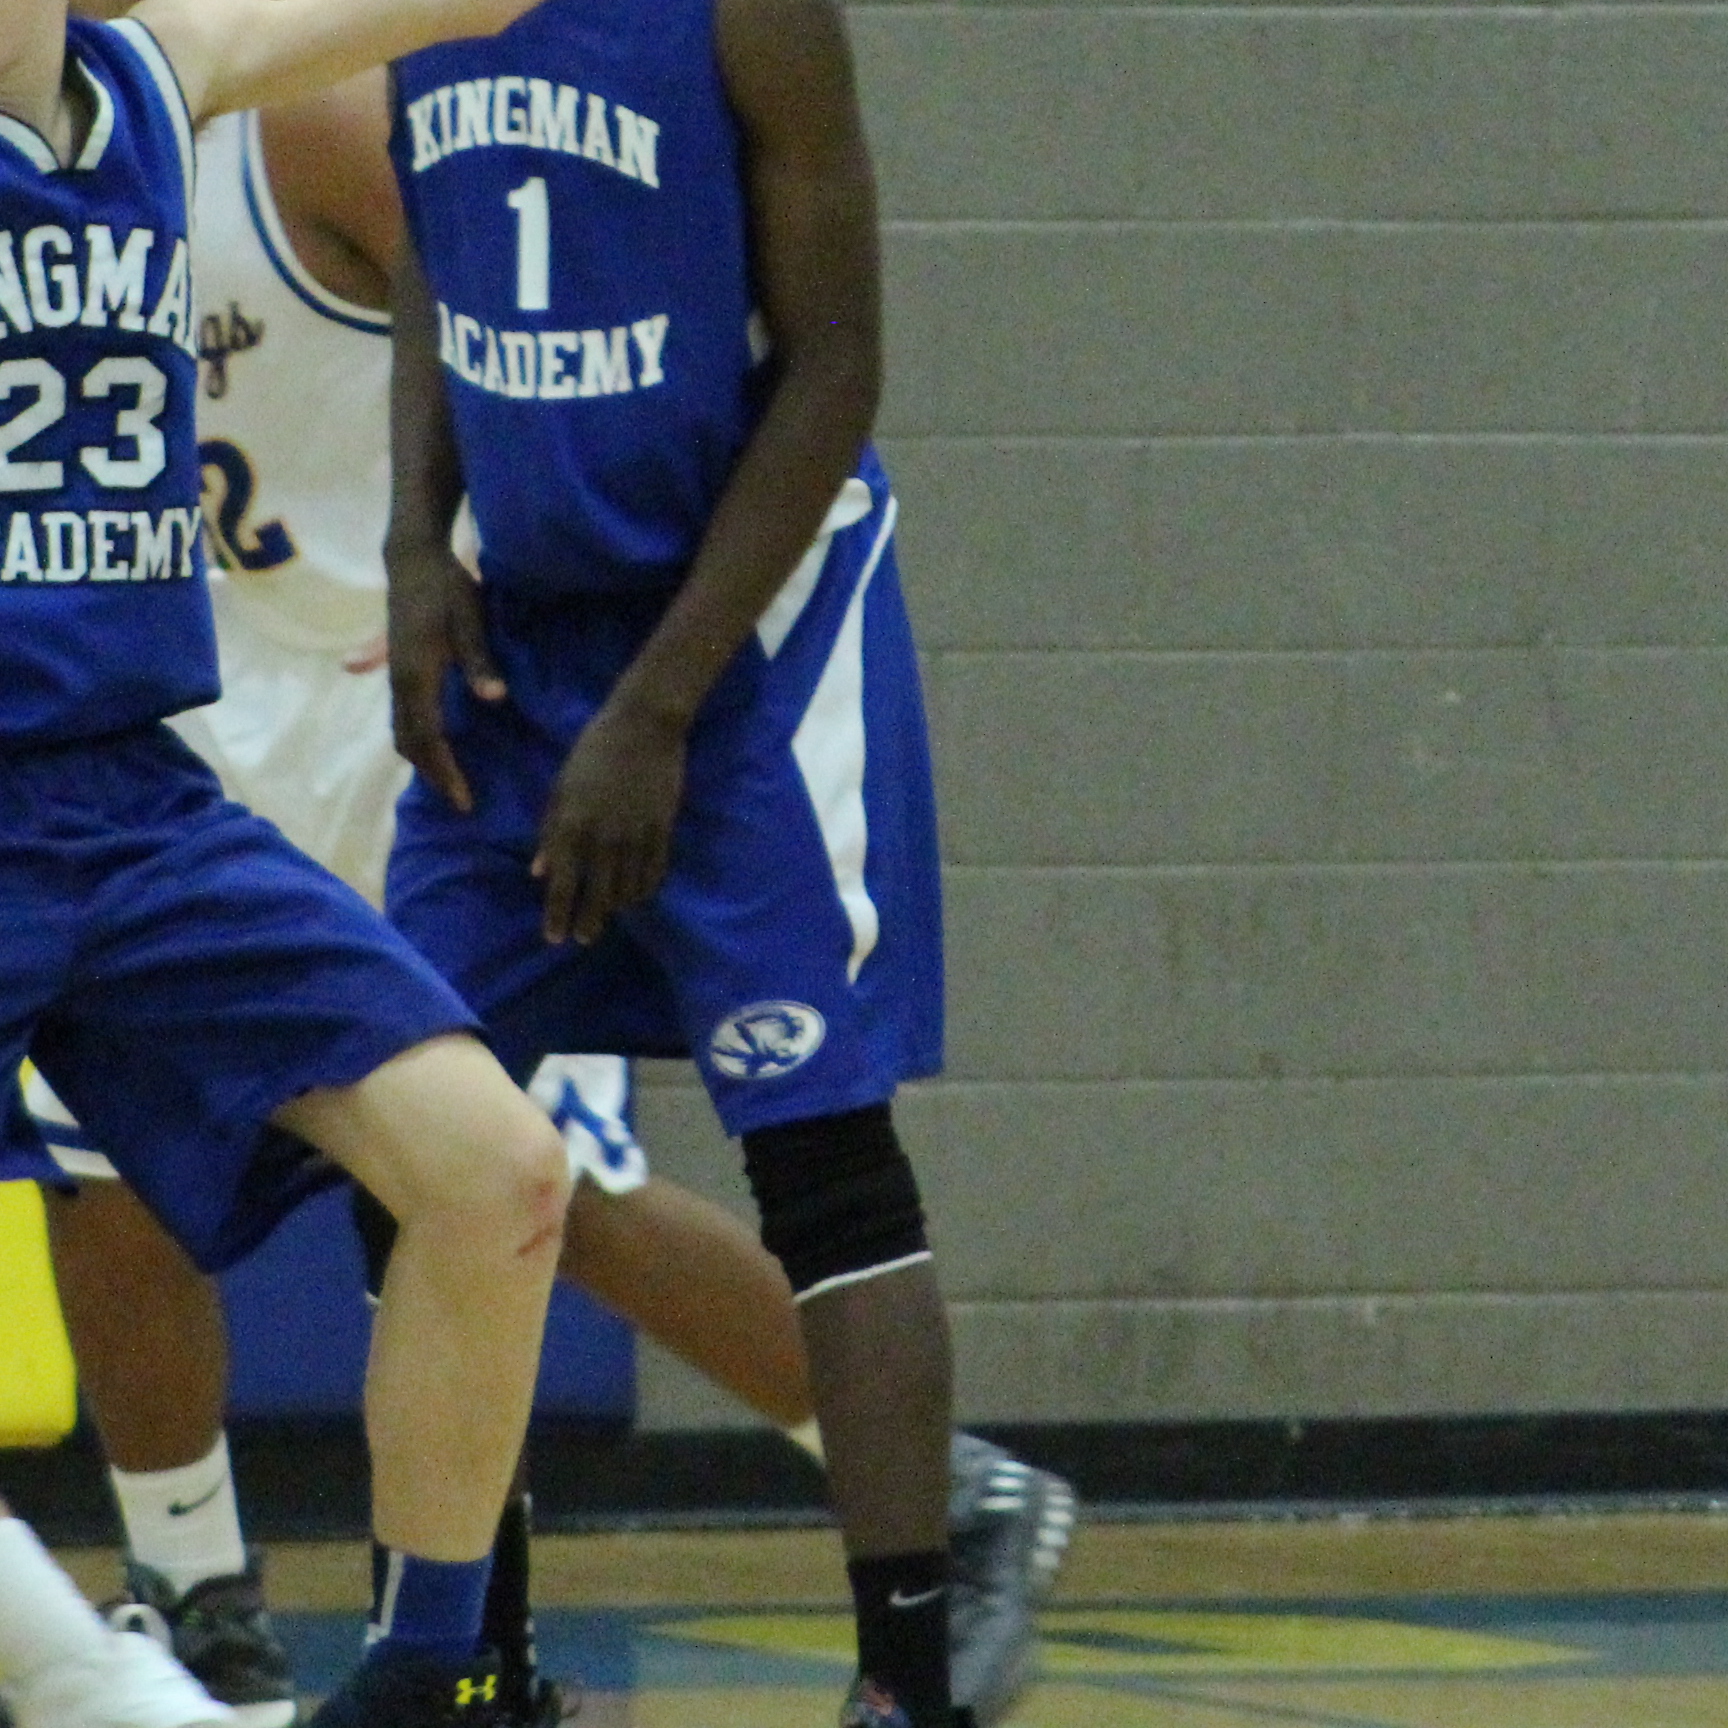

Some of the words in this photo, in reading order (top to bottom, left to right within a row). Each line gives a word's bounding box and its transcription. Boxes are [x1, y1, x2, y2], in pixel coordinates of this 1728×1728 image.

[406, 75, 661, 189] KINGMAN
[506, 176, 551, 311] 1
[437, 299, 671, 401] ACADEMY
